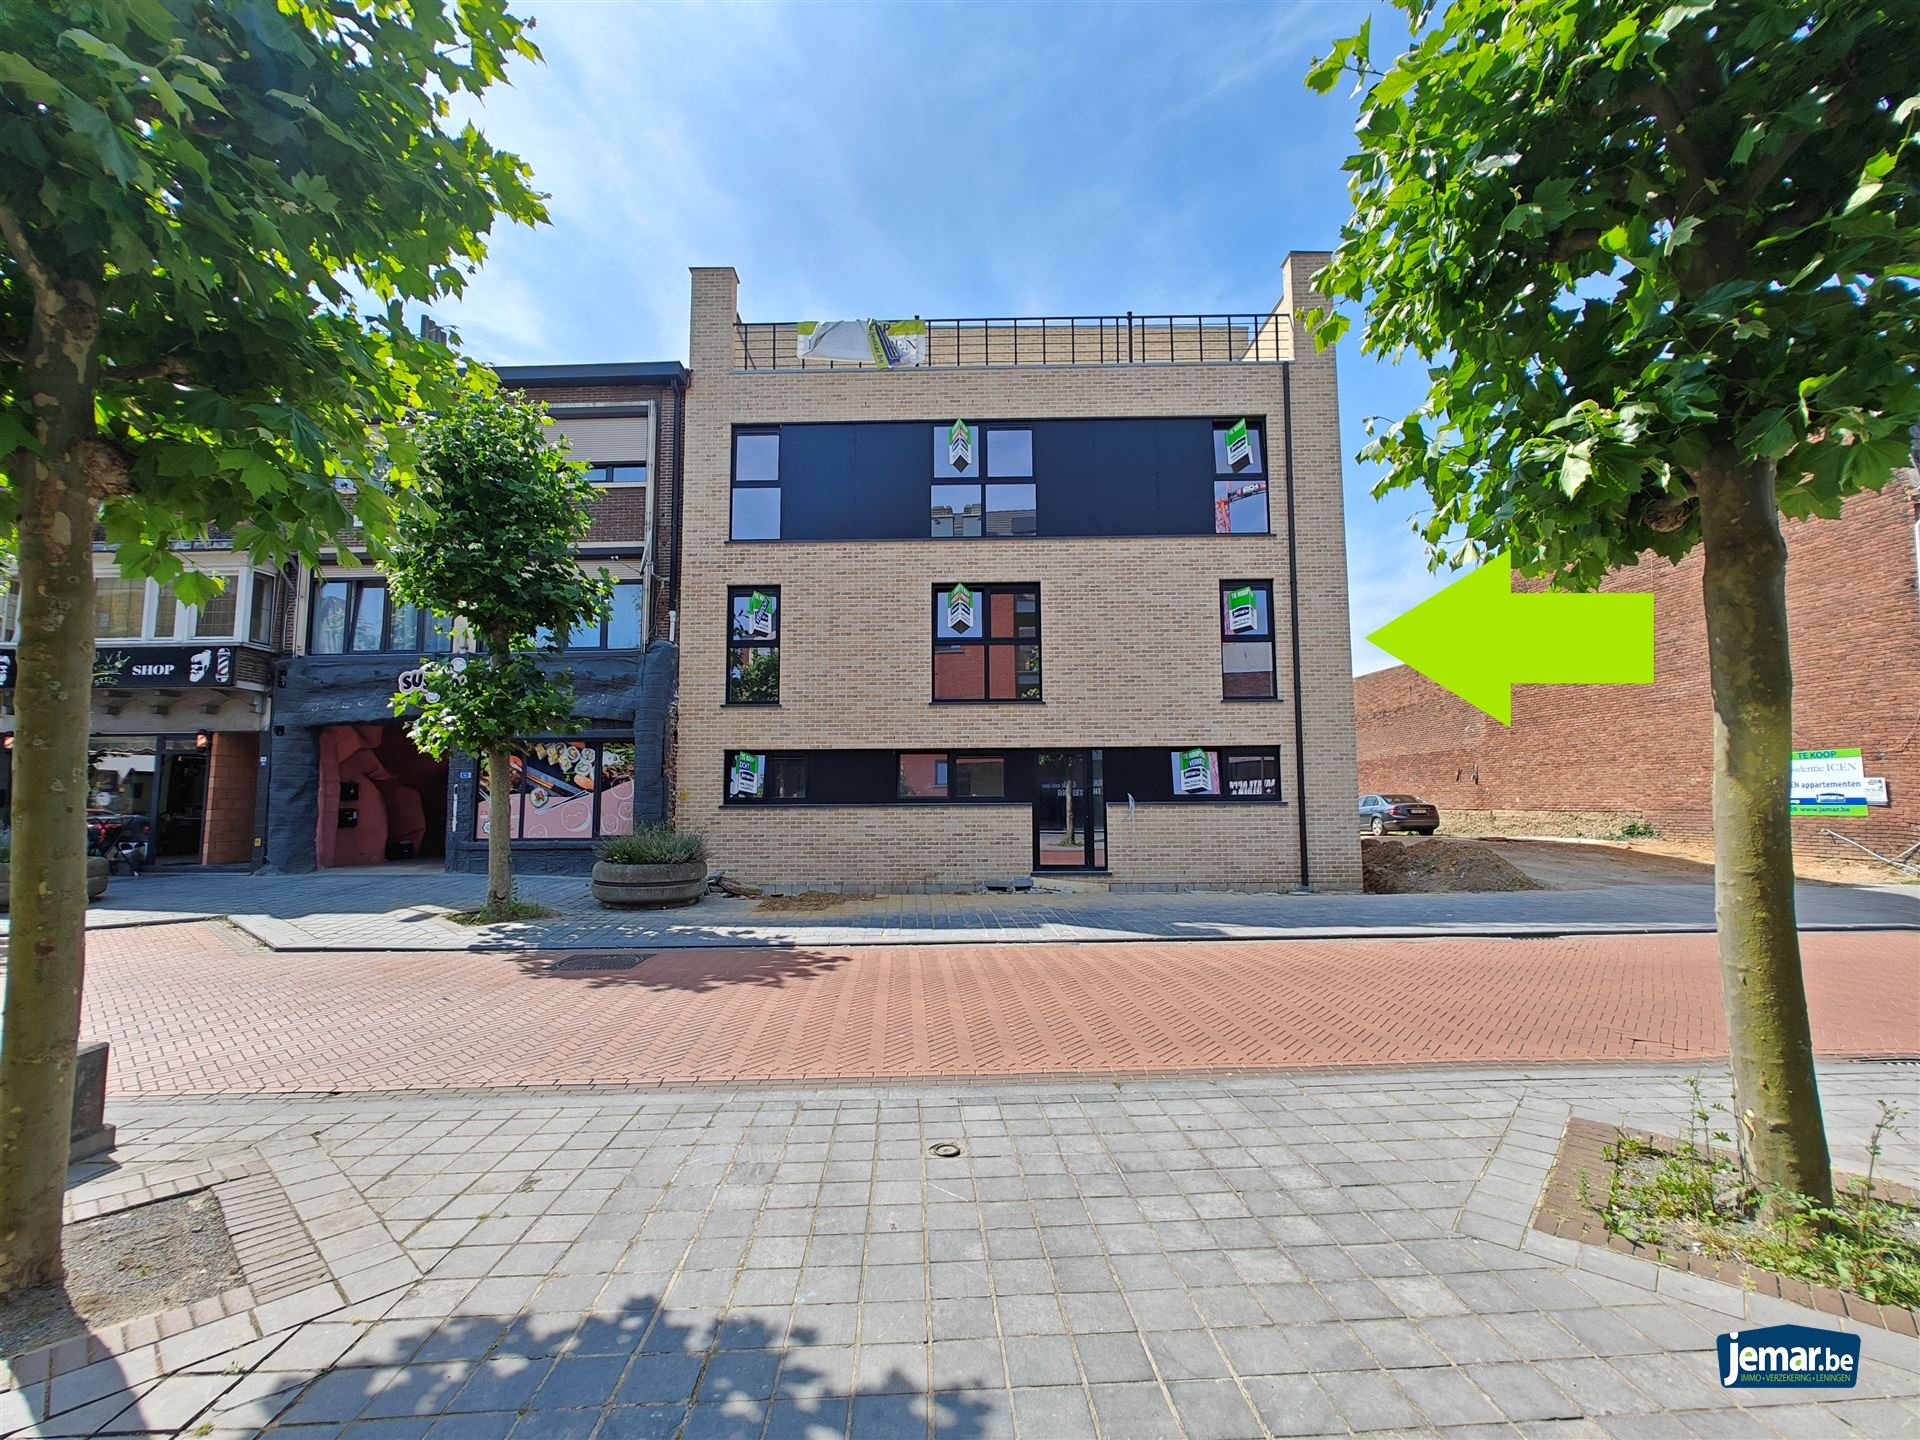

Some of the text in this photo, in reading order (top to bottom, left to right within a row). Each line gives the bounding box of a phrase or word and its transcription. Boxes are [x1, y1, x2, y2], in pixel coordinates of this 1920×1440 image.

[132, 665, 176, 676] SHOP
[1810, 750, 1836, 759] KOOP
[1826, 762, 1857, 772] ICEN
[1801, 780, 1861, 789] appartementen
